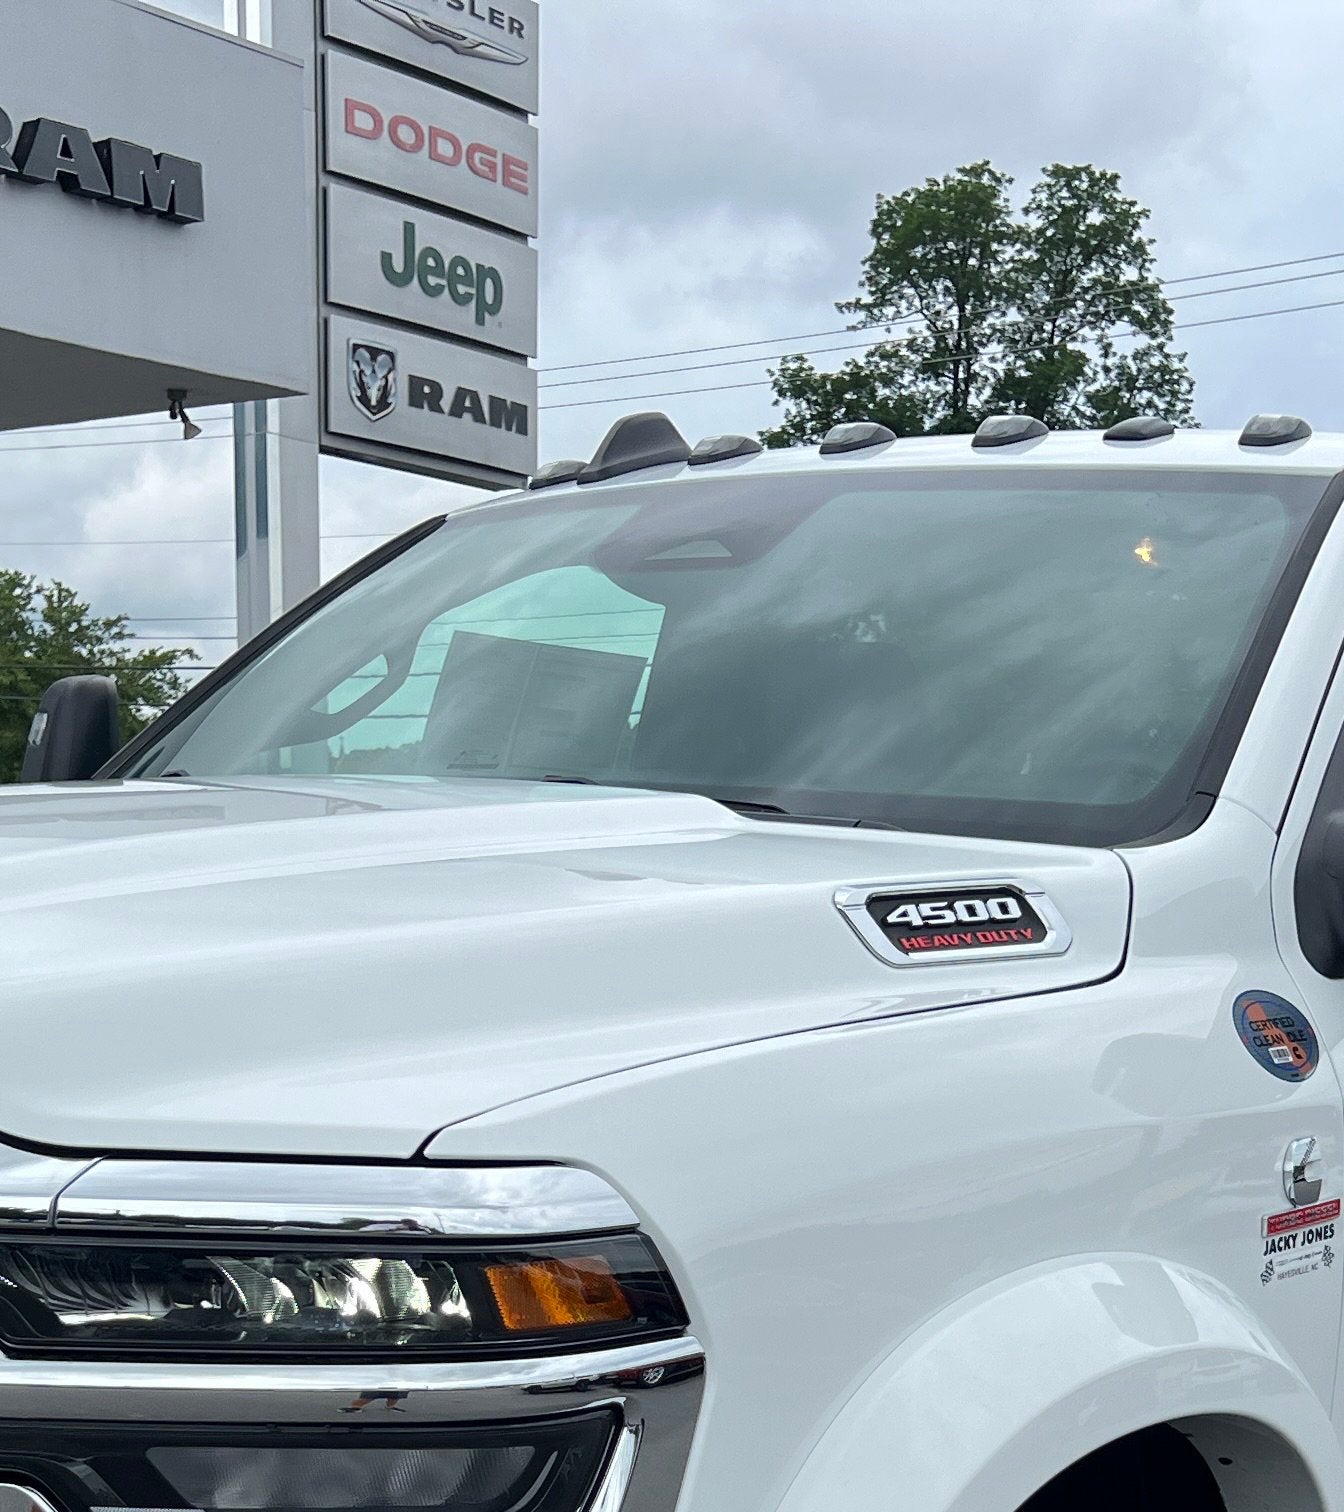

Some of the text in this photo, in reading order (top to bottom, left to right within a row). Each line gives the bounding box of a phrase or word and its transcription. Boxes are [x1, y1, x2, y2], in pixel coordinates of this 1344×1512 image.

[344, 97, 530, 196] DODGE
[380, 219, 504, 327] Jeep
[407, 374, 529, 437] RAM
[886, 897, 1022, 927] 4500
[900, 927, 1034, 950] HEAVY DUTY
[1252, 1032, 1286, 1048] CLEAN
[1263, 1223, 1335, 1257] JACKY JONES
